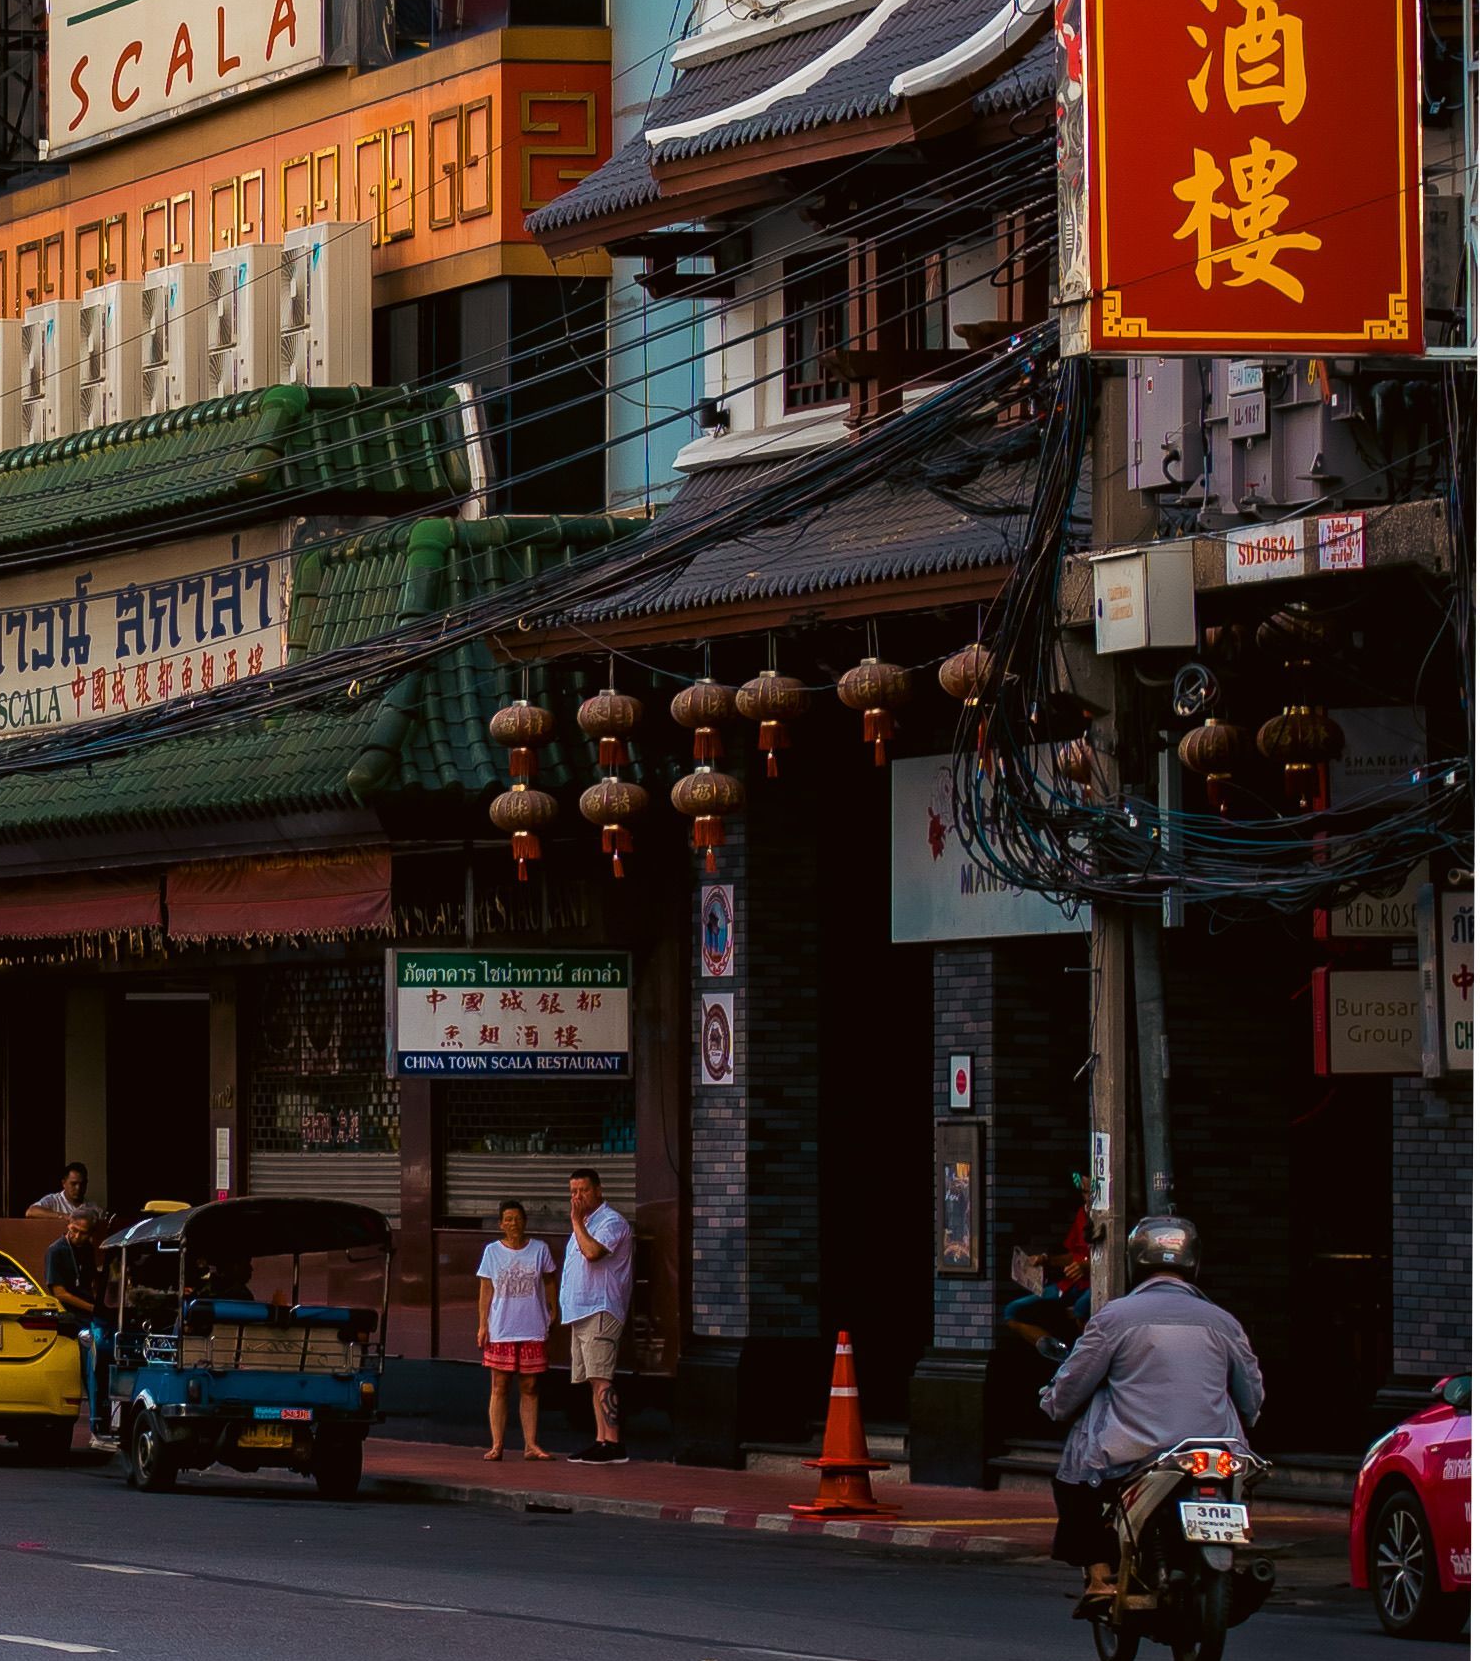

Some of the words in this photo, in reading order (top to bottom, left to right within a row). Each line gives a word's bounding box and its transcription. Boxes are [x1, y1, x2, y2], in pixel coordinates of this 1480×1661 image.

[116, 534, 273, 658] สกาล่า
[1345, 903, 1374, 928] RED
[403, 961, 476, 983] ภัตตาคาร
[479, 960, 563, 983] ไชน่าทาวน์
[571, 962, 621, 983] สกาล่า
[425, 988, 603, 1015] 中國城銀都
[440, 1024, 583, 1050] 魚翅酒樓
[1348, 1024, 1413, 1047] Group
[404, 1056, 445, 1069] CHINA
[449, 1056, 487, 1069] TOWN
[491, 1056, 533, 1069] SCALA
[537, 1056, 621, 1070] RESTAURANT
